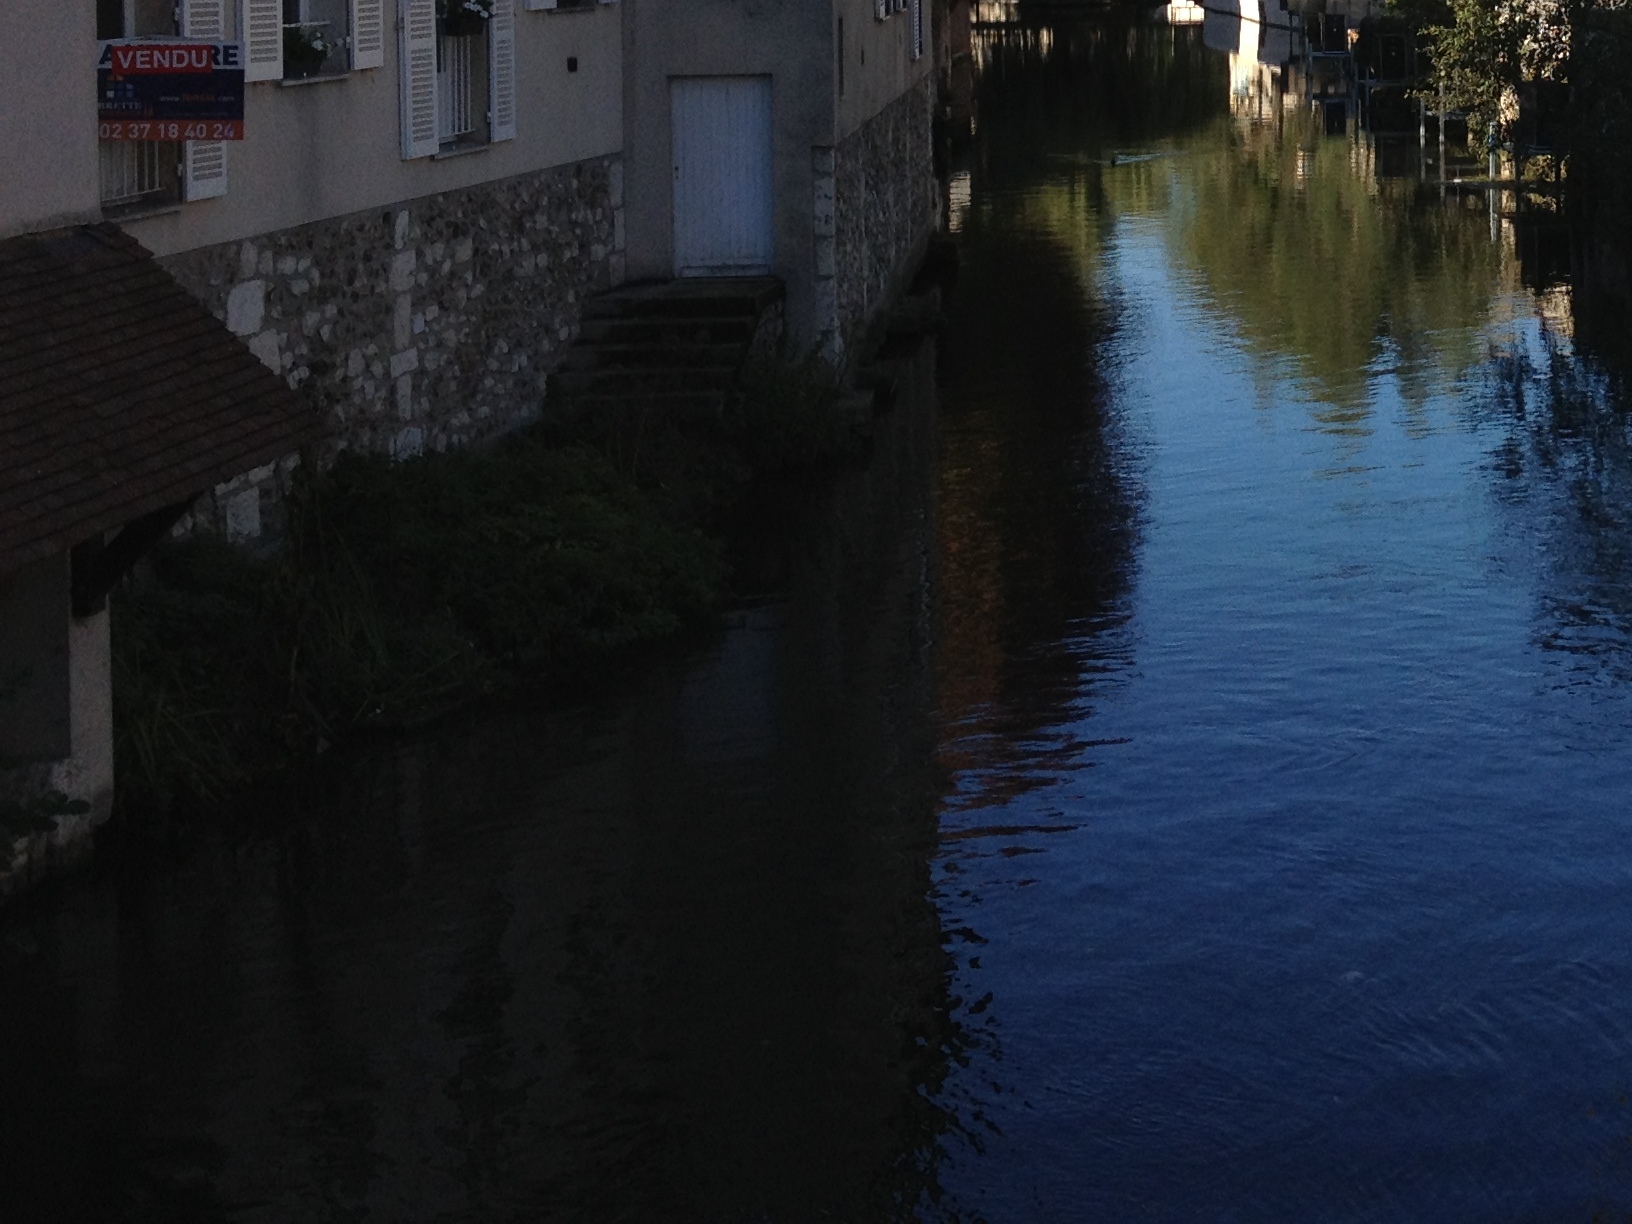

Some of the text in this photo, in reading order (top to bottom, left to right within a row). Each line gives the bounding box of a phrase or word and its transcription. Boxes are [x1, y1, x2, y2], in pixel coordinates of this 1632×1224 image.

[116, 49, 208, 69] VENDU
[100, 124, 122, 139] 02
[128, 124, 150, 139] 37
[157, 124, 179, 139] 18
[184, 123, 207, 138] 40
